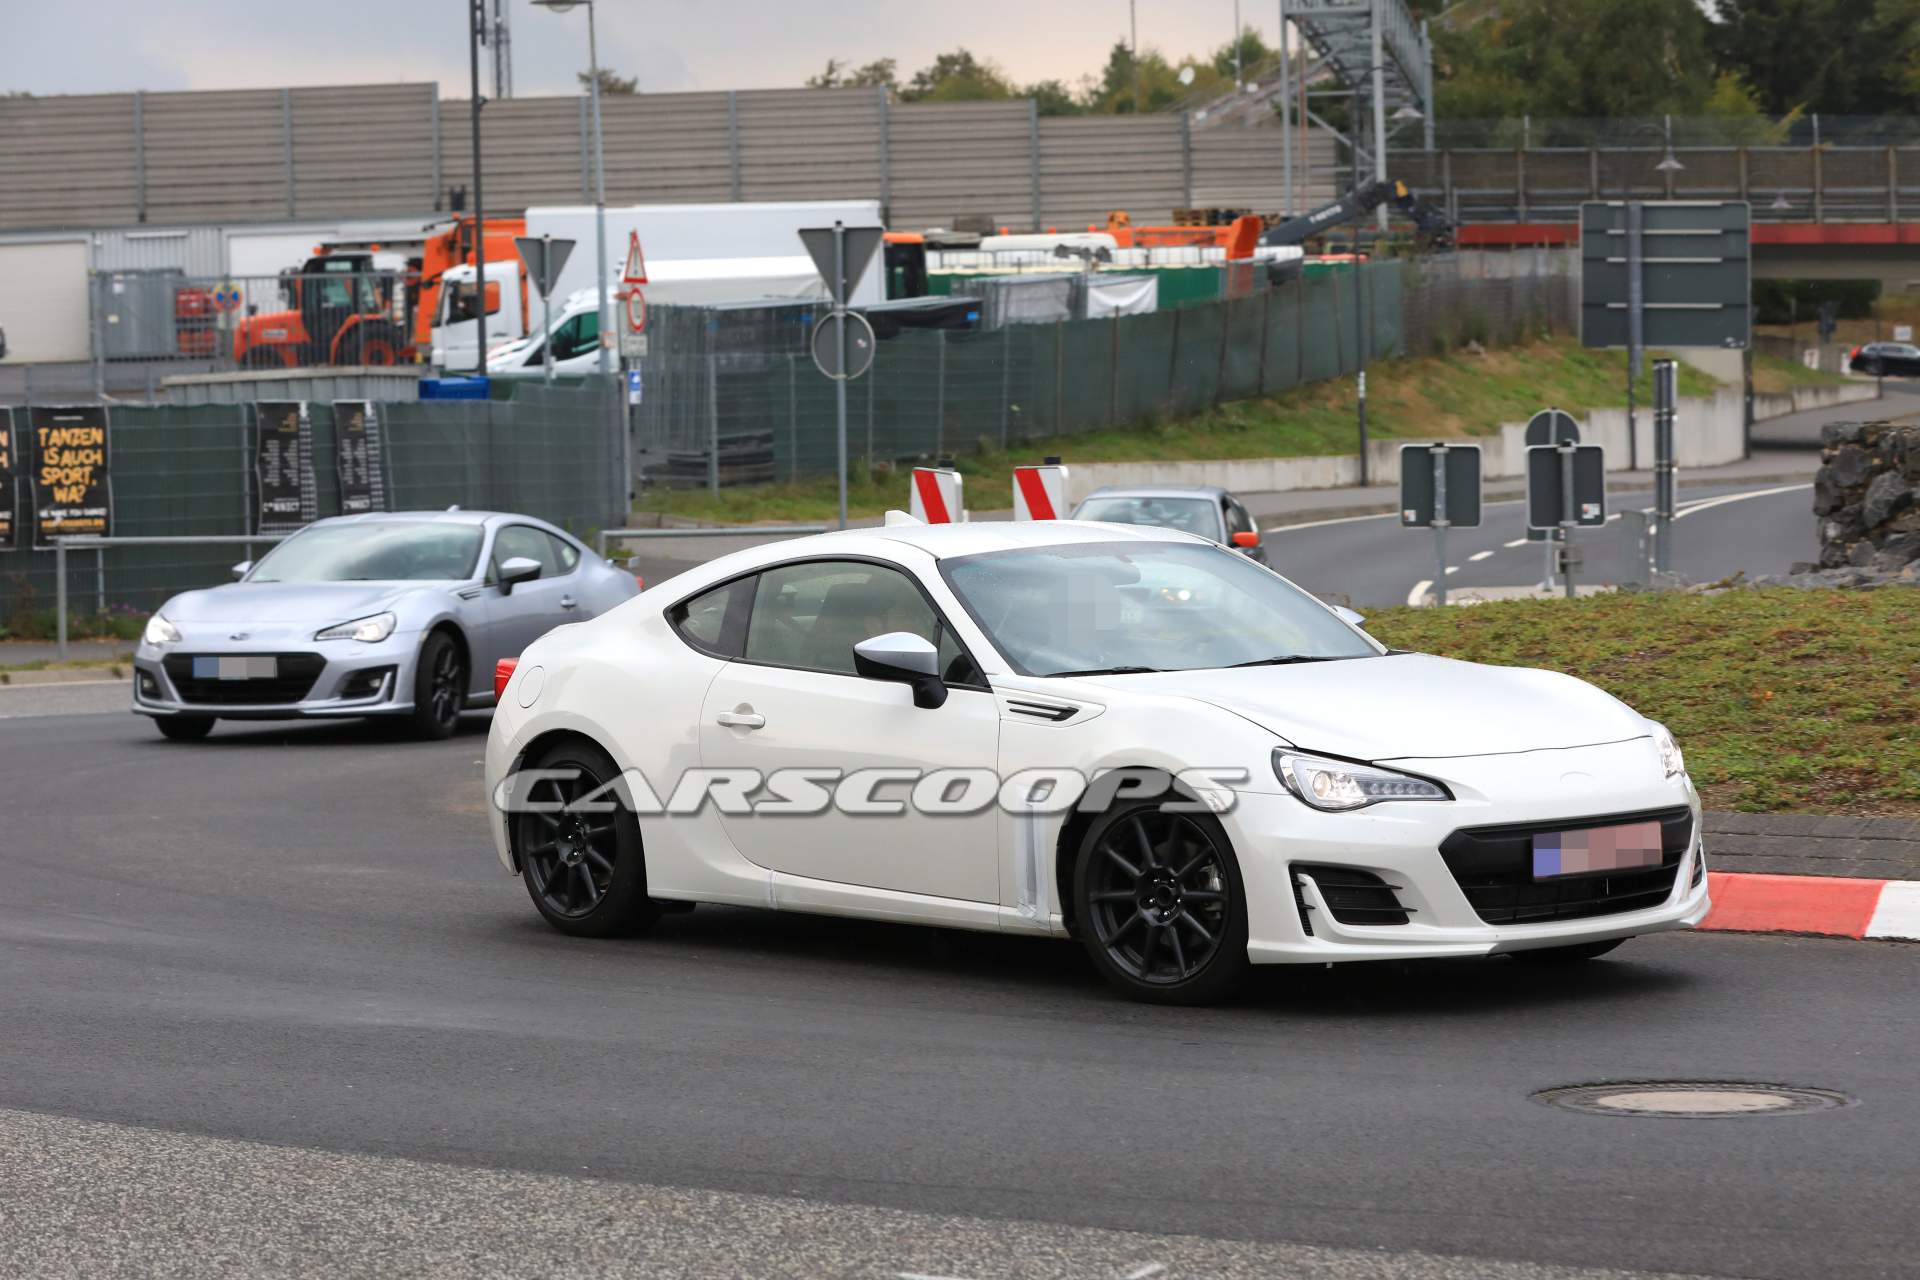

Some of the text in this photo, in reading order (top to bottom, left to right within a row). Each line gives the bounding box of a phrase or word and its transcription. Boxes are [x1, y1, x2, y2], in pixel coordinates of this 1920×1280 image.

[38, 427, 104, 447] TANZEN
[44, 447, 103, 467] IS AUCH
[40, 466, 97, 486] SPORT.
[53, 485, 87, 503] WA?
